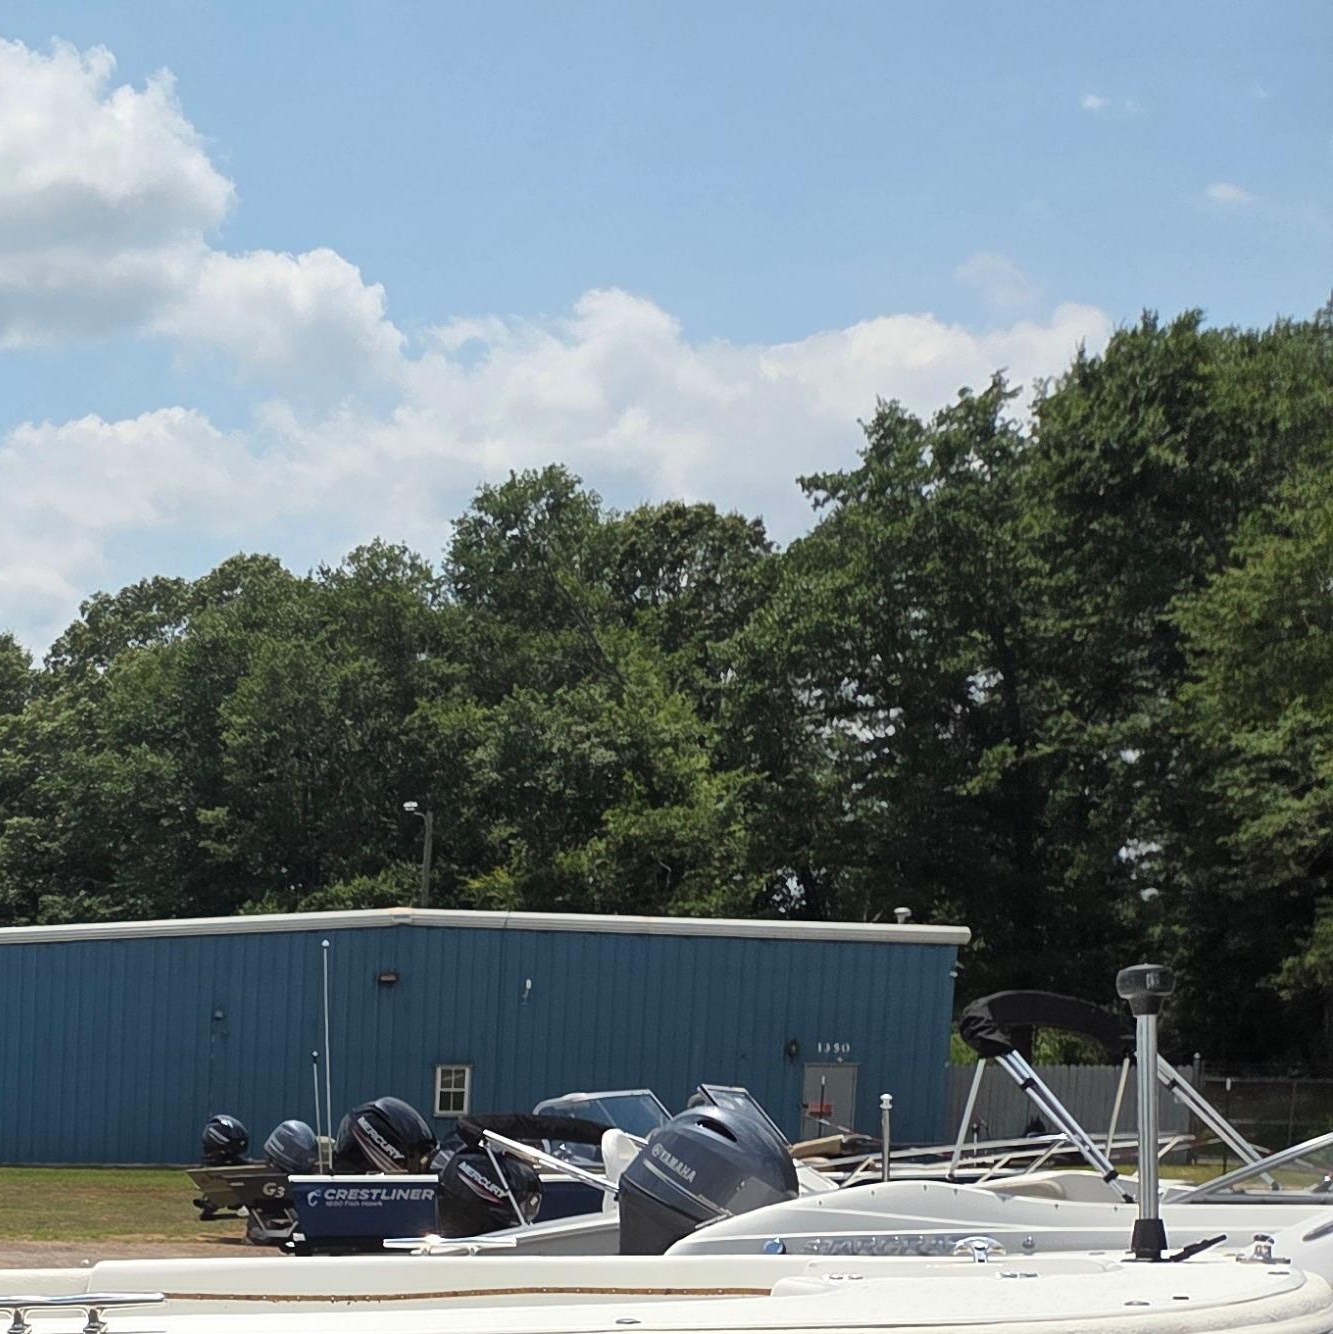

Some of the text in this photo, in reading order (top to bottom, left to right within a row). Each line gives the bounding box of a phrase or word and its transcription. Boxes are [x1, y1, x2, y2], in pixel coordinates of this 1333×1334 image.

[357, 1116, 406, 1161] MERCURY
[262, 1182, 286, 1198] G3
[458, 1161, 511, 1199] MERCURY
[323, 1188, 436, 1202] CRESTLINER
